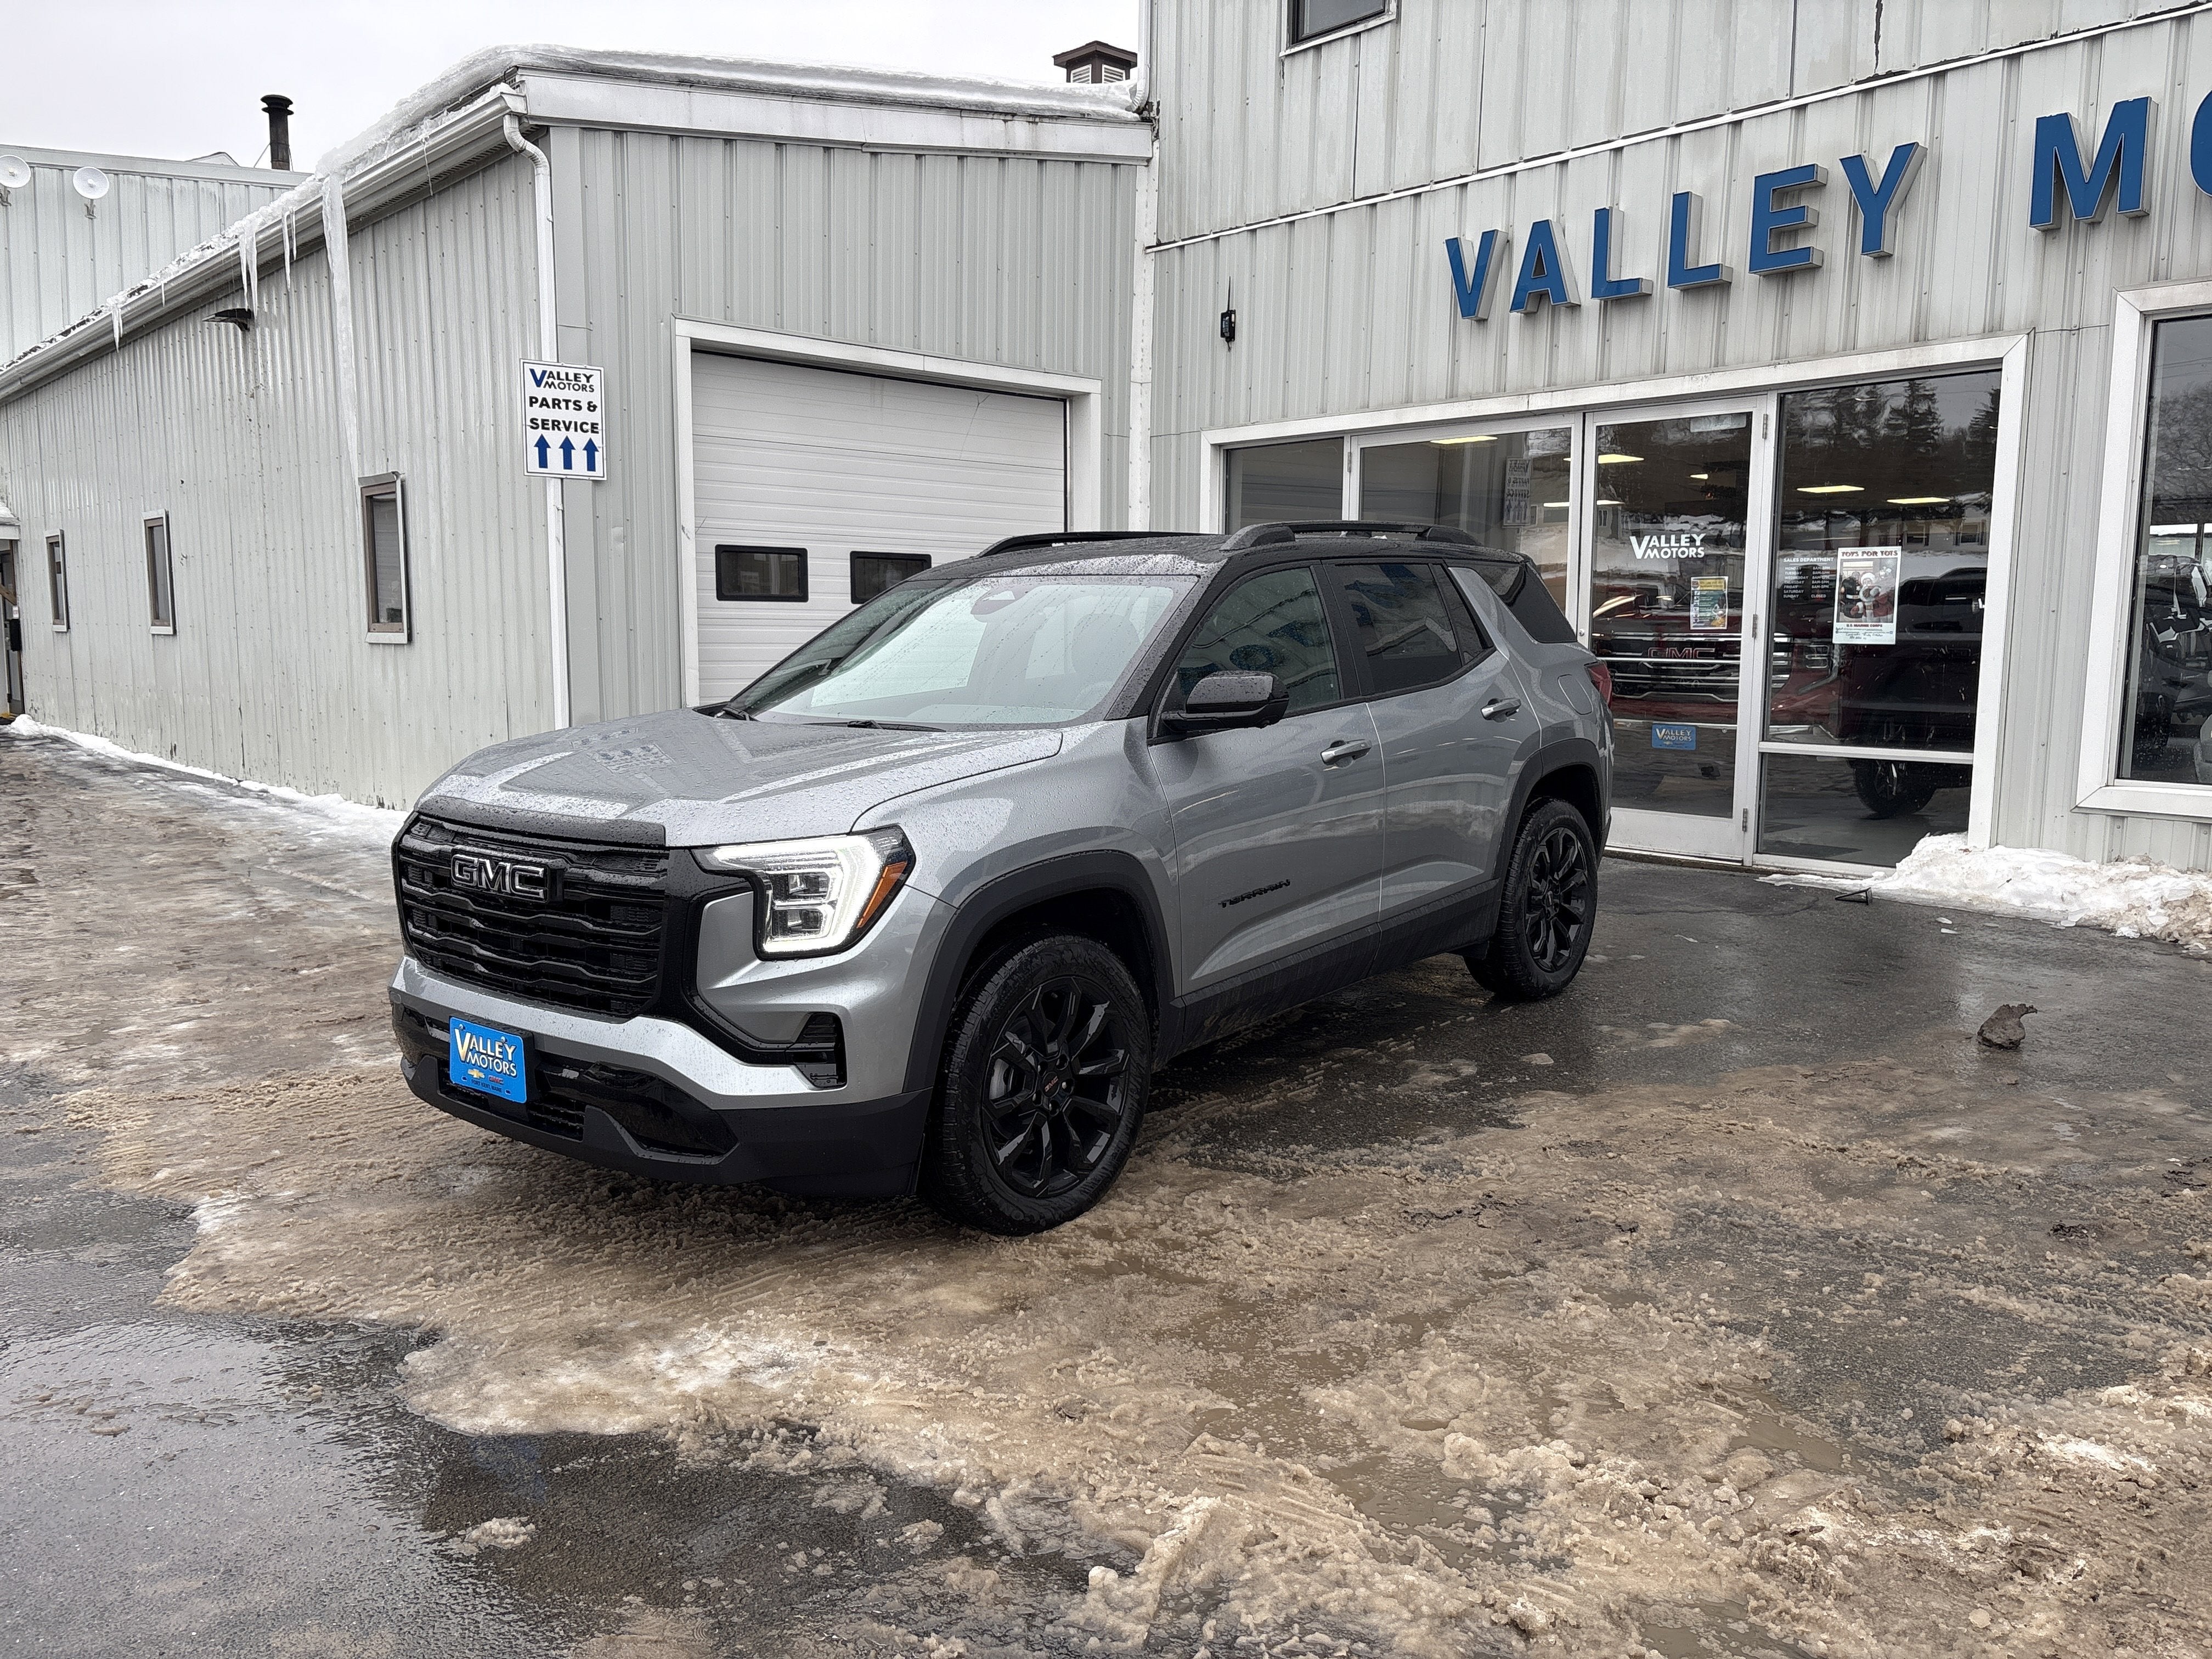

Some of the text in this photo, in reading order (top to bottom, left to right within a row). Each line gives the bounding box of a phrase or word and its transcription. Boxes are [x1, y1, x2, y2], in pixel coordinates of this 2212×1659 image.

[1445, 90, 2212, 321] VALLEY M
[529, 368, 594, 388] VALLEY
[543, 381, 594, 393] MOTORS
[529, 396, 597, 412] PARTS &
[529, 417, 599, 434] SERVICE
[1629, 533, 1706, 559] VALLEY
[1644, 547, 1705, 558] MOTORS
[1647, 647, 1716, 659] GMC
[1656, 728, 1691, 739] VALLEY
[451, 854, 545, 899] GMC
[454, 1028, 517, 1062] VALLEY
[466, 1051, 517, 1077] MOTORS
[1044, 1075, 1059, 1092] GMC
